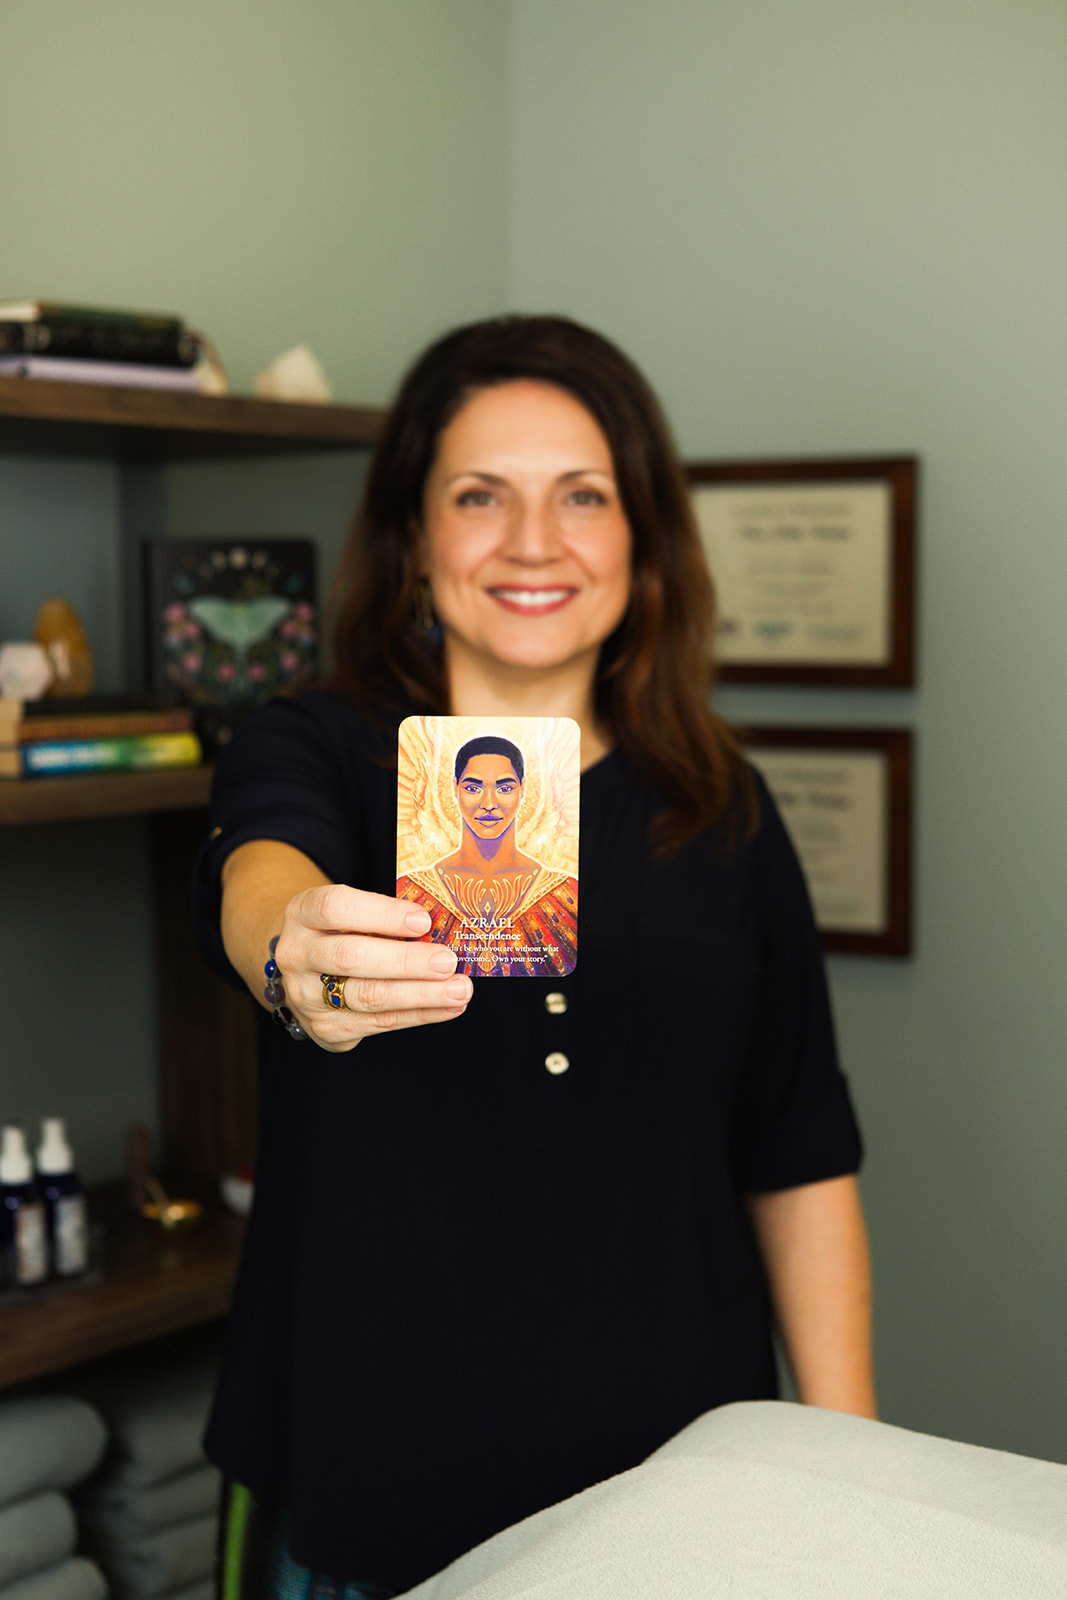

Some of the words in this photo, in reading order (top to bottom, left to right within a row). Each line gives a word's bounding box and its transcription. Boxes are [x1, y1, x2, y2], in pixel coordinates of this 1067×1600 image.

[459, 917, 516, 928] AZRAEL
[453, 930, 522, 940] Transcendence
[464, 944, 473, 952] be
[474, 944, 489, 952] who
[490, 946, 501, 954] you
[515, 944, 541, 952] without
[542, 943, 560, 952] what
[492, 955, 509, 963] Own
[510, 956, 526, 964] your
